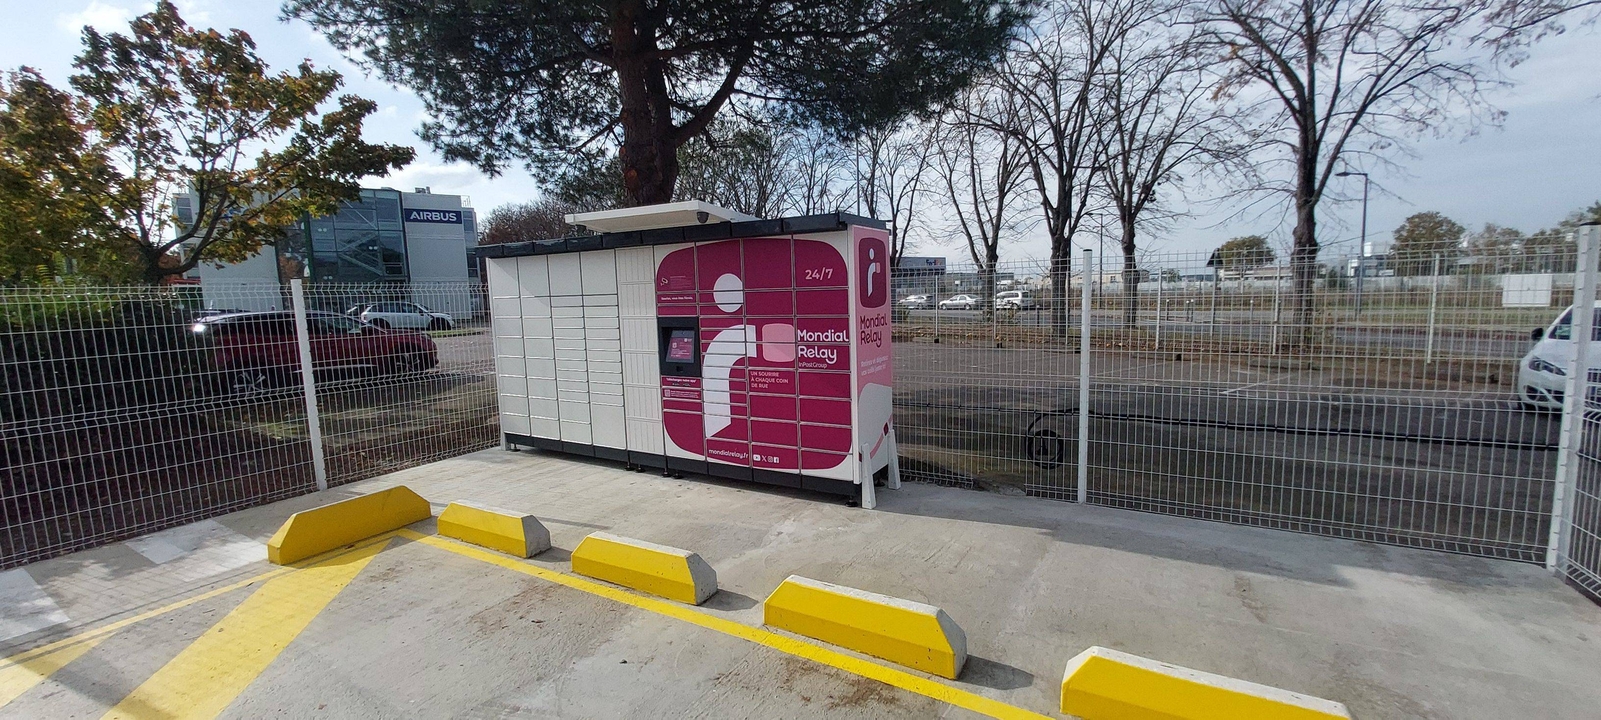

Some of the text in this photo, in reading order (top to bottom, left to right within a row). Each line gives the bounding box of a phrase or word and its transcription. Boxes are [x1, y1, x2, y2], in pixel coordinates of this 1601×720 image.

[410, 211, 457, 221] AIRBUS
[805, 267, 833, 280] 24/7
[860, 313, 887, 330] Mondial
[797, 329, 849, 342] Mondial
[860, 329, 882, 348] Relay
[798, 345, 837, 364] Relay
[708, 449, 748, 459] mondialrelay.fr
